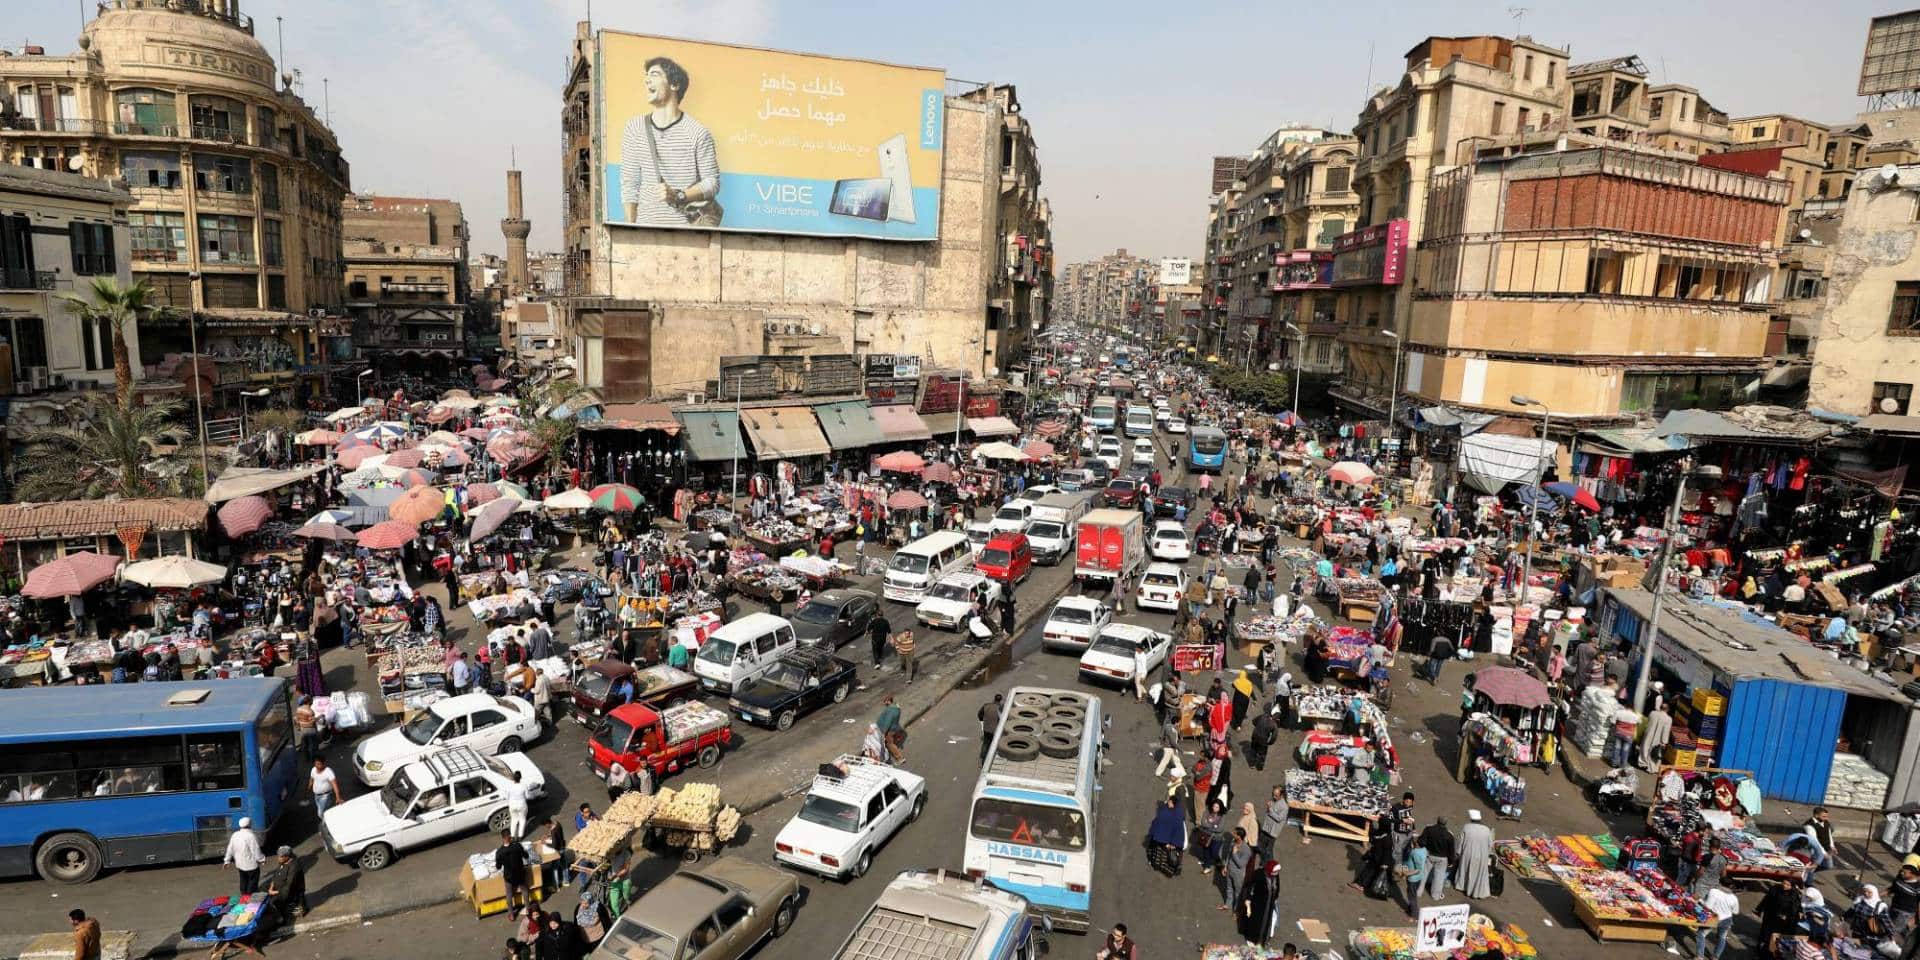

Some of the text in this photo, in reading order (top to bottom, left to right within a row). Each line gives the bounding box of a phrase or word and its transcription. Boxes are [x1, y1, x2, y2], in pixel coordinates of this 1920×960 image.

[759, 72, 844, 101] خليك جاهز
[807, 102, 845, 126] مهما
[922, 94, 936, 145] Lenovo
[755, 181, 814, 204] VIBE
[1170, 262, 1186, 271] TOP
[871, 355, 893, 366] BLACK
[987, 842, 1068, 864] HASSAAN
